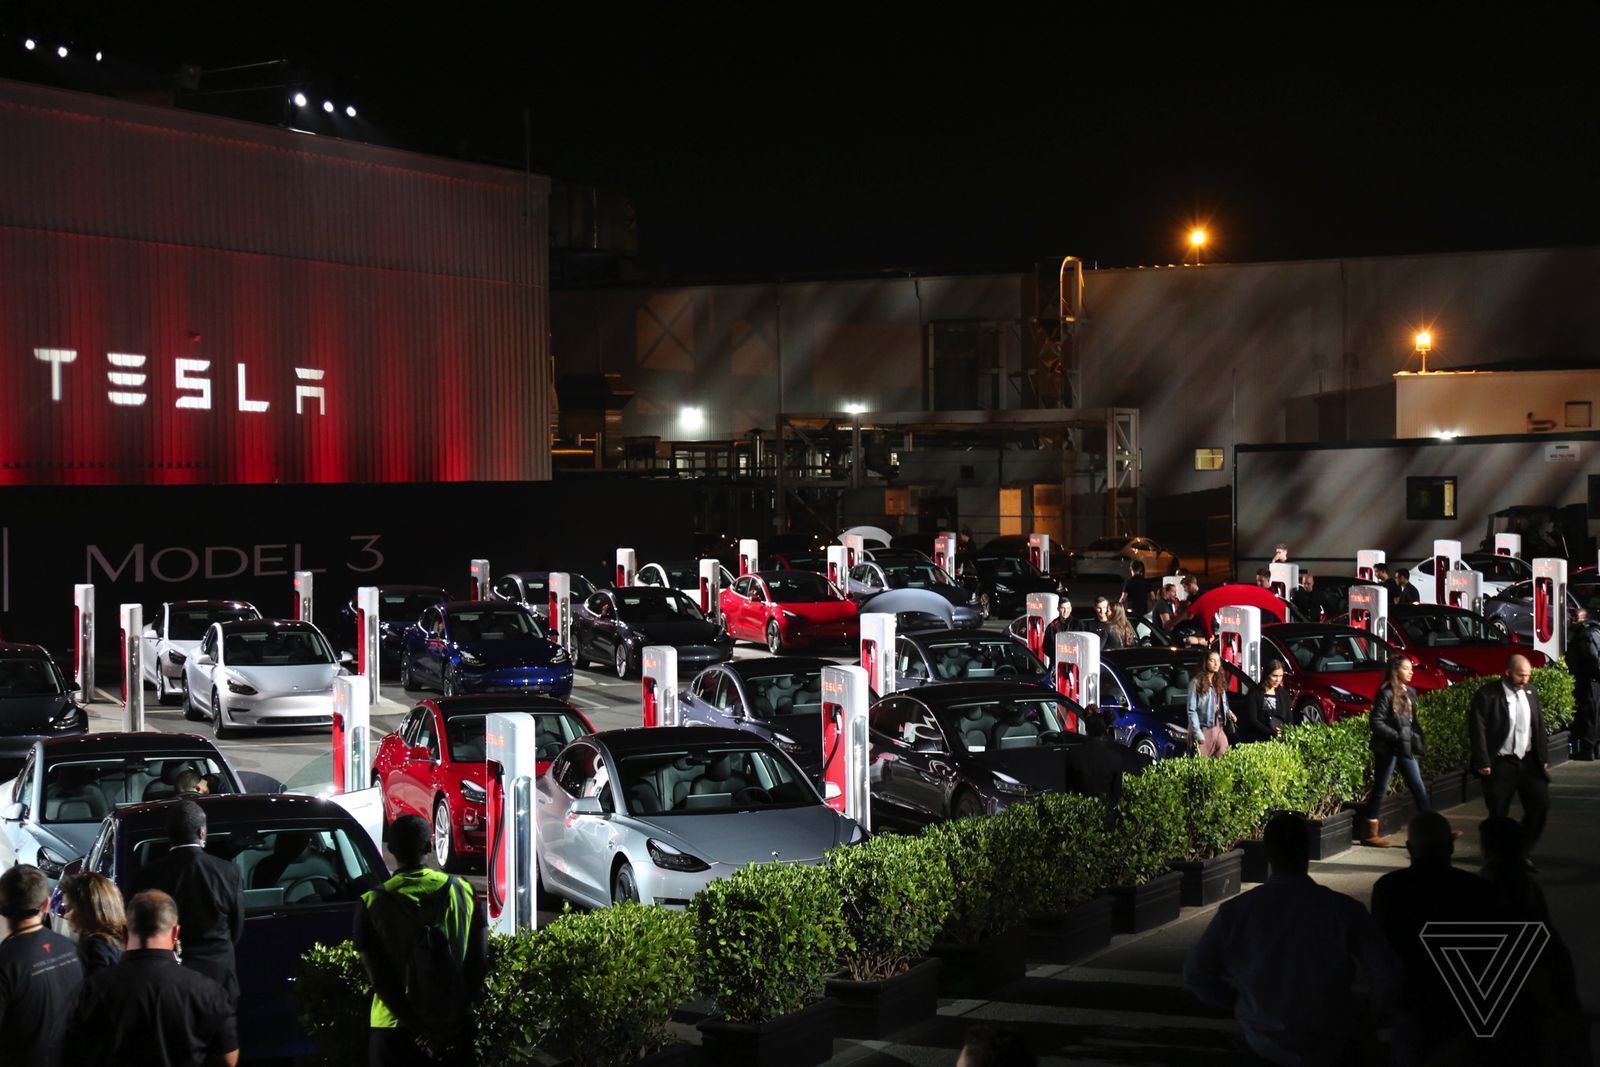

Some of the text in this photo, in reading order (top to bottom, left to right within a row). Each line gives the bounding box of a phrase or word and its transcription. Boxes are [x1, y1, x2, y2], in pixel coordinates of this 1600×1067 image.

[34, 347, 325, 416] TESLA
[86, 534, 384, 584] MODEL 3
